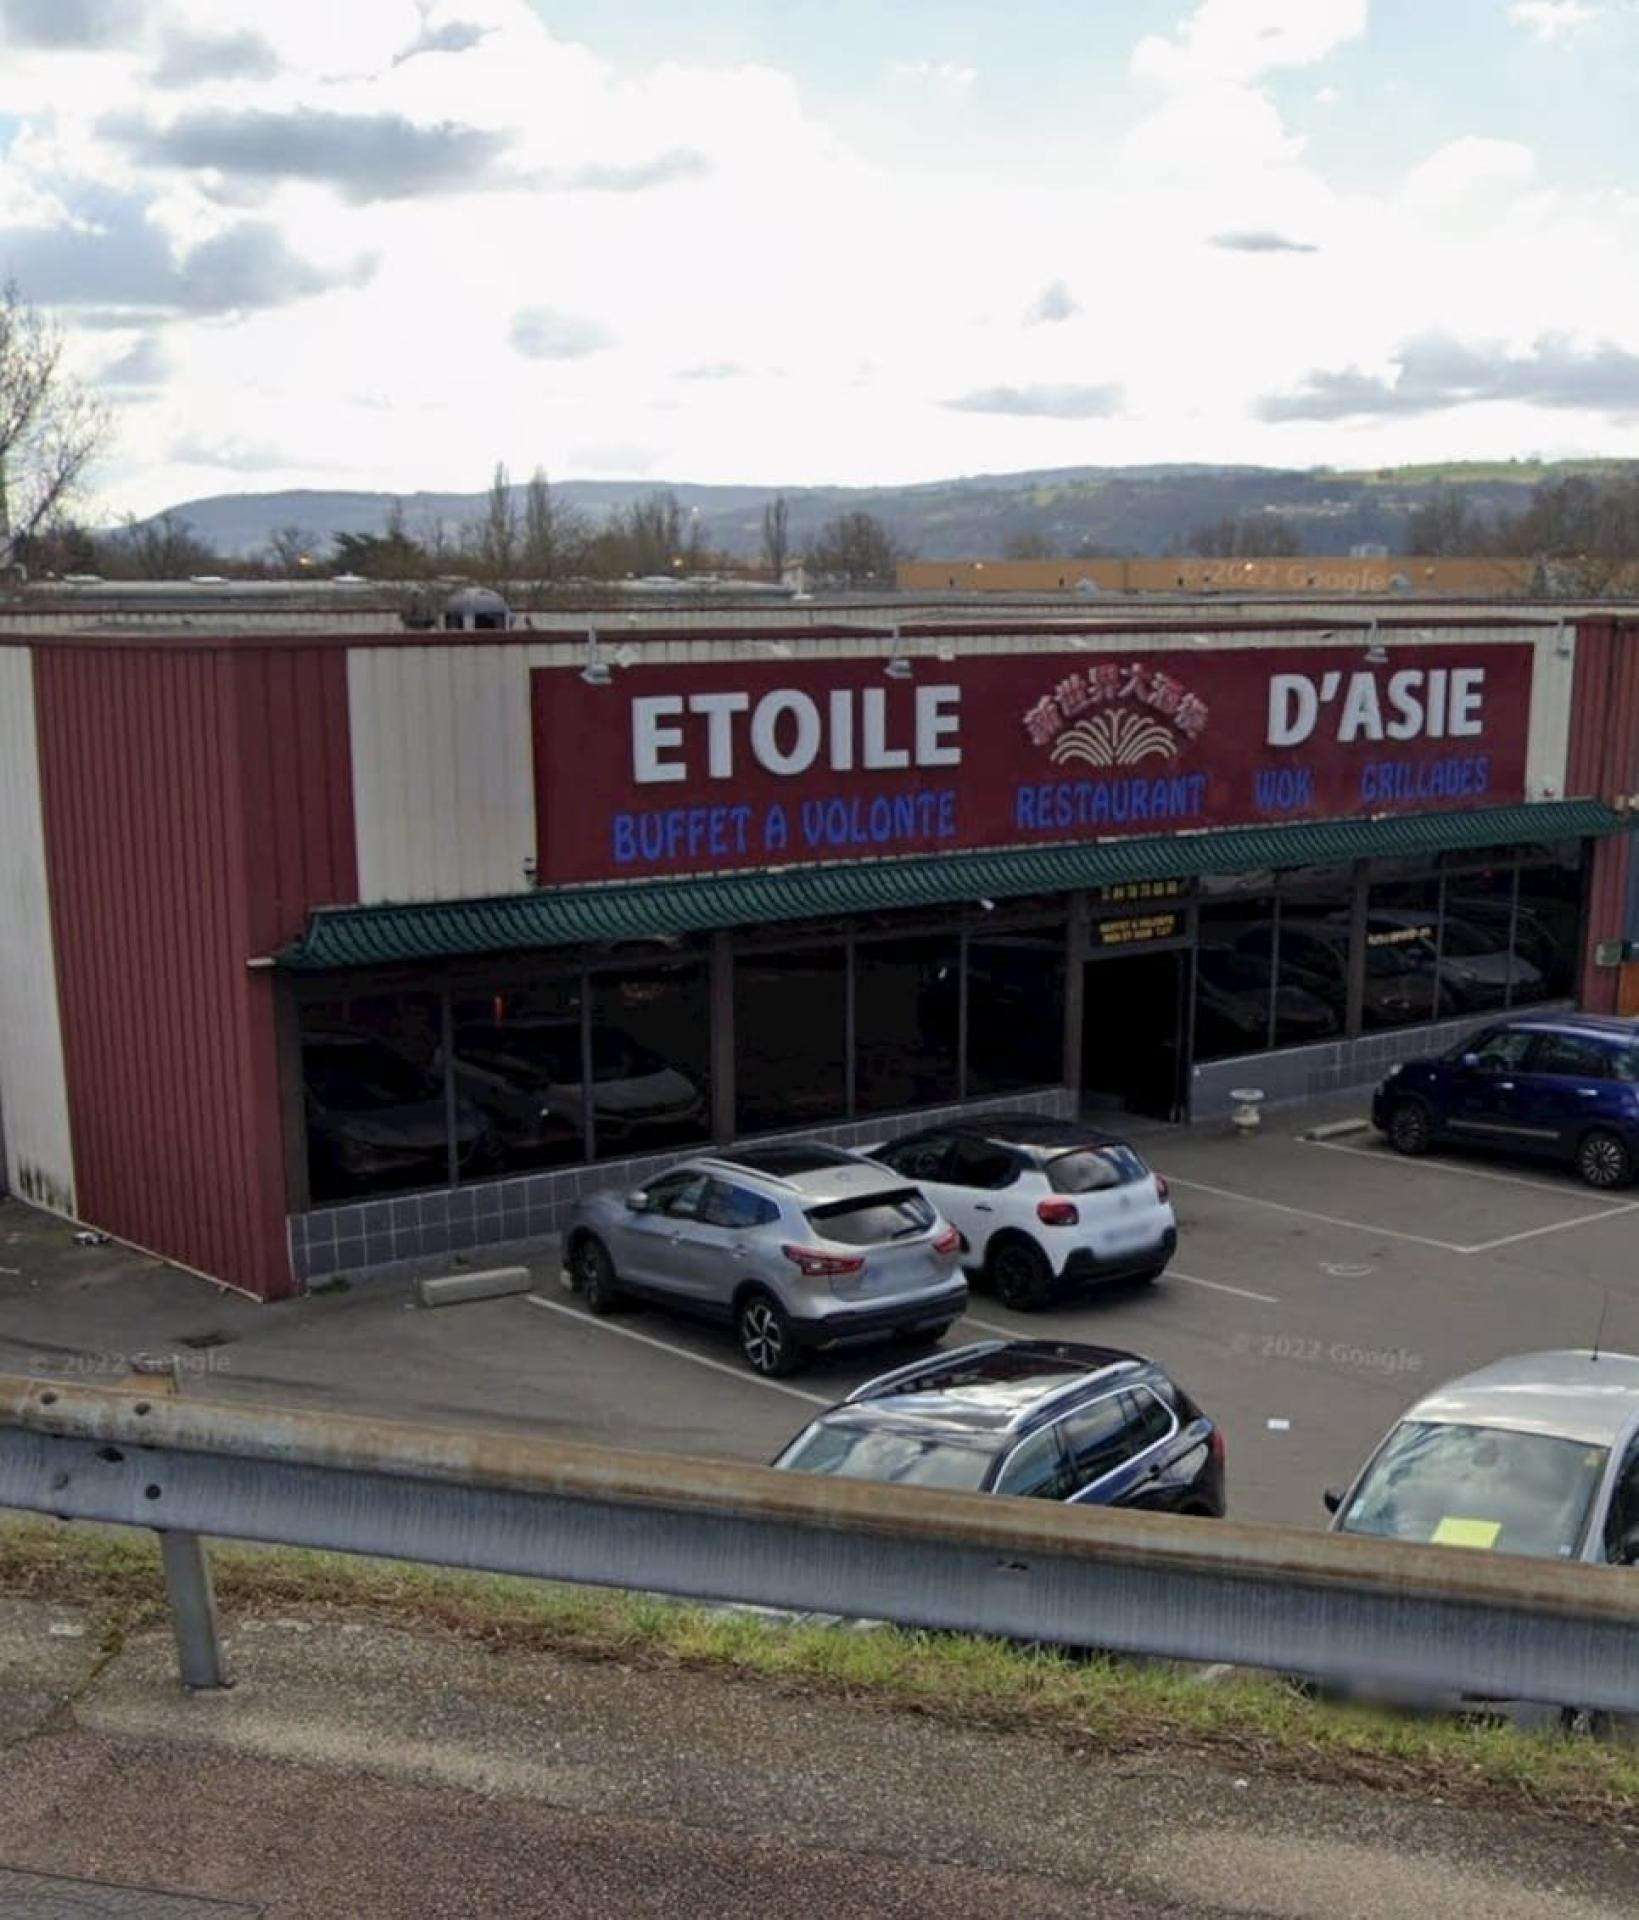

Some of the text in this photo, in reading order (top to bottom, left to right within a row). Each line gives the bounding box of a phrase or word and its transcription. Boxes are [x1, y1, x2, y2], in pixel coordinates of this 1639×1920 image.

[631, 667, 1486, 784] ETOILE D'ASIE
[1016, 773, 1207, 829] RESTAURANT
[1255, 769, 1315, 811] WOK
[1361, 757, 1490, 801] GRILLADES
[612, 791, 956, 866] BUFFET A VOLONTE
